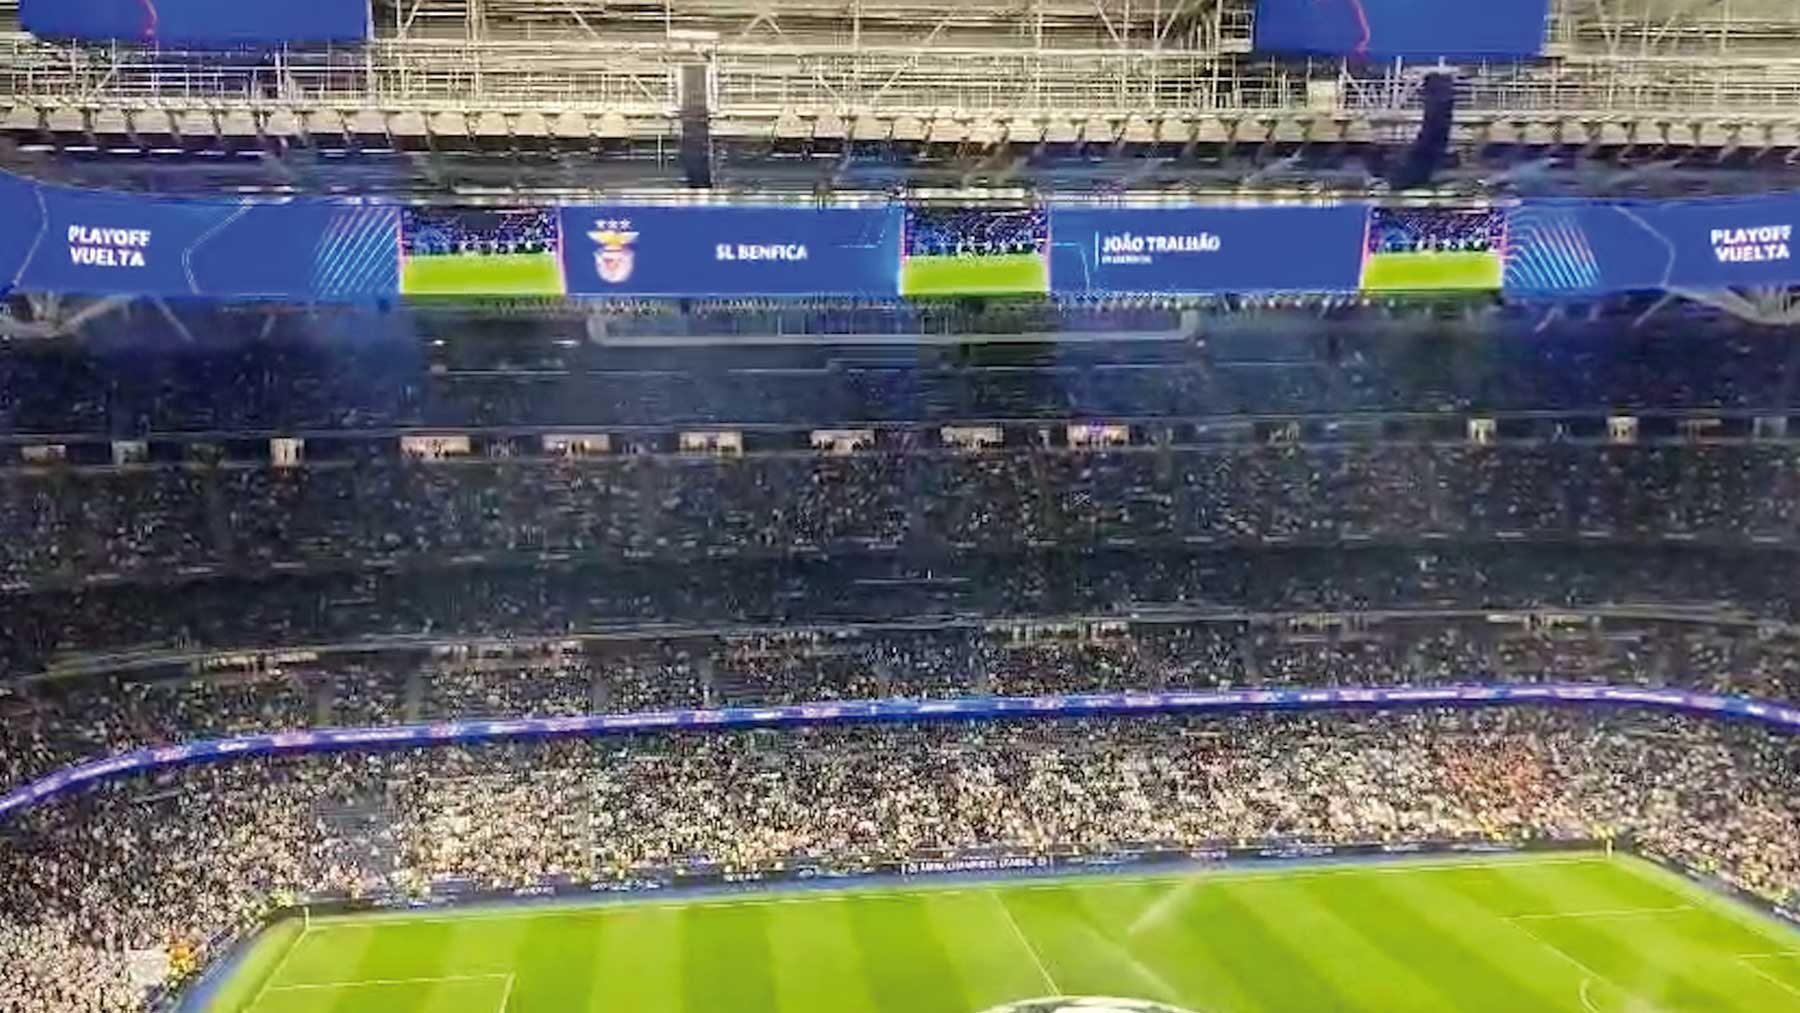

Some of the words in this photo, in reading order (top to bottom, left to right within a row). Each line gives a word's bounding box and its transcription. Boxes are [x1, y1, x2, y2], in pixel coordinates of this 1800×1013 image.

[68, 225, 151, 247] PLAYOFF
[1102, 232, 1144, 252] JOÃO
[1711, 225, 1792, 245] PLAYOFF
[70, 246, 145, 266] VUELTA
[715, 242, 736, 260] SL
[738, 242, 808, 260] BENFICA
[1715, 243, 1790, 262] VUELTA
